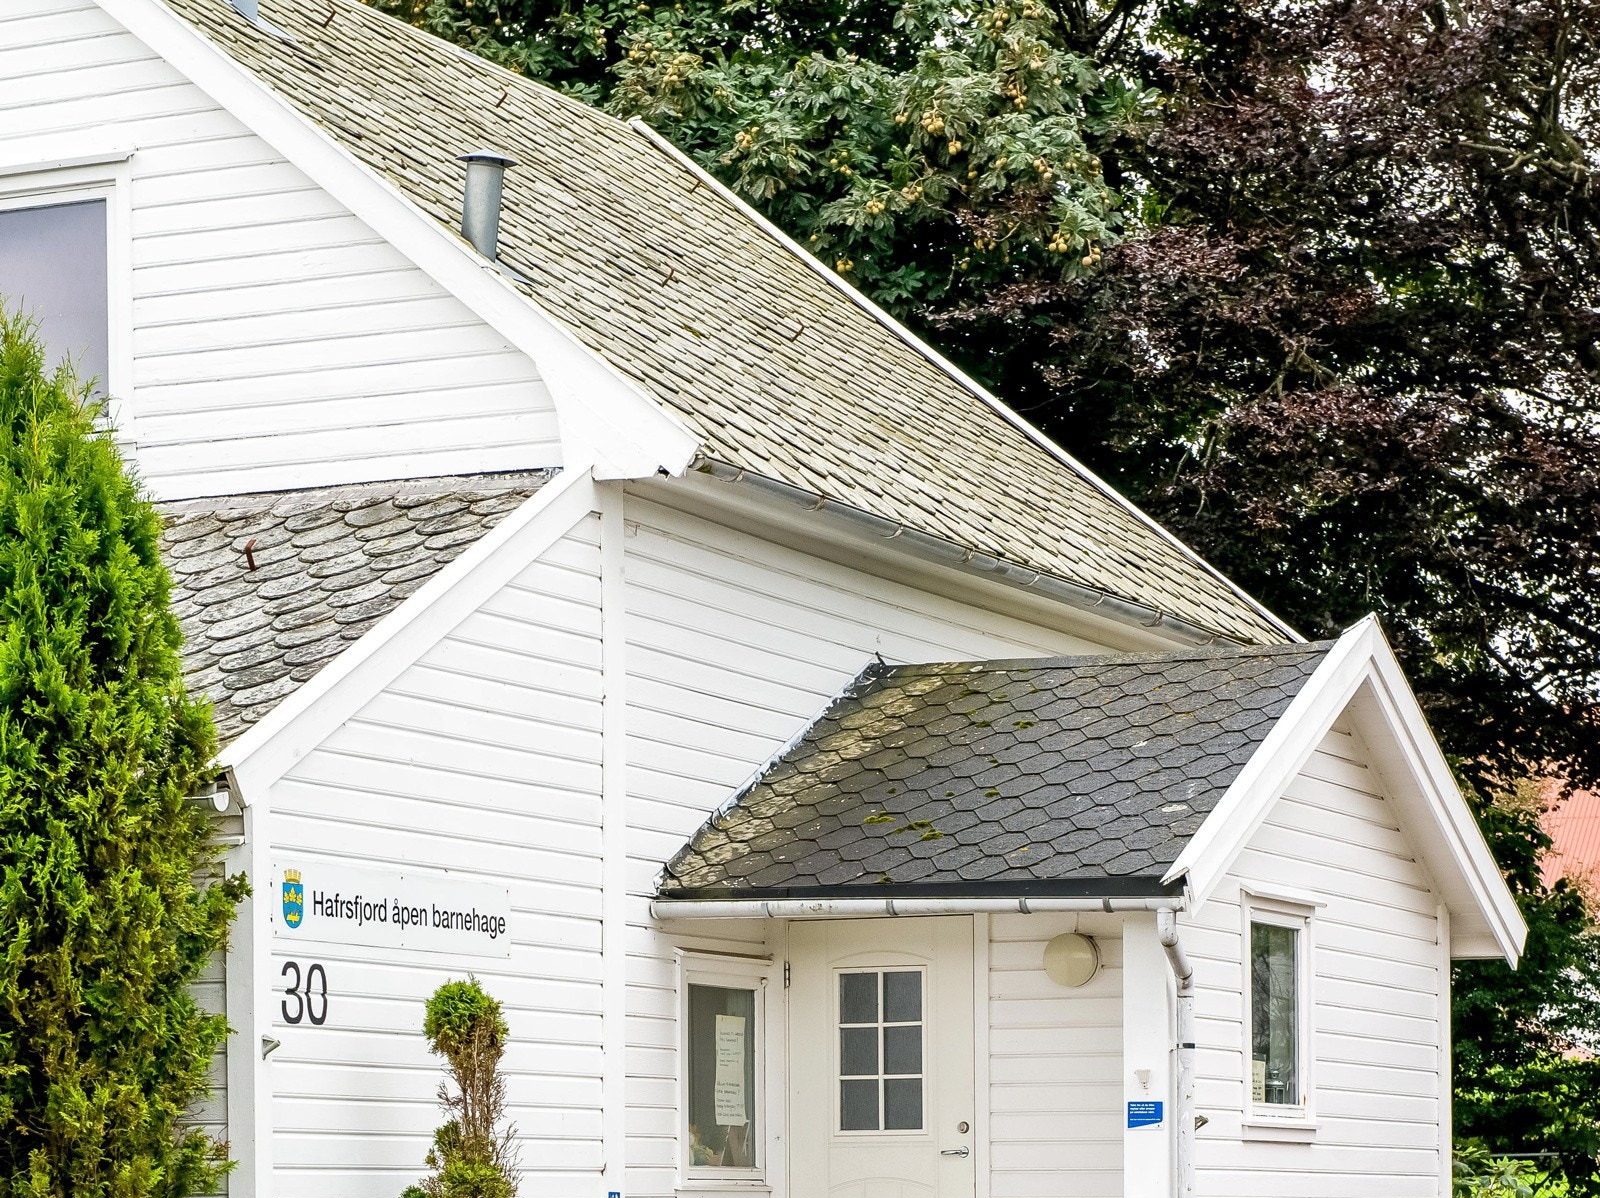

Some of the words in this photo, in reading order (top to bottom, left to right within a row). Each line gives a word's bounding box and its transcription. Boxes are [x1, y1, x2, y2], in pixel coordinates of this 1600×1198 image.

[313, 890, 388, 927] Hafrsfjord
[392, 898, 428, 931] åpen
[432, 903, 506, 940] barnehage
[281, 961, 328, 1026] 30
